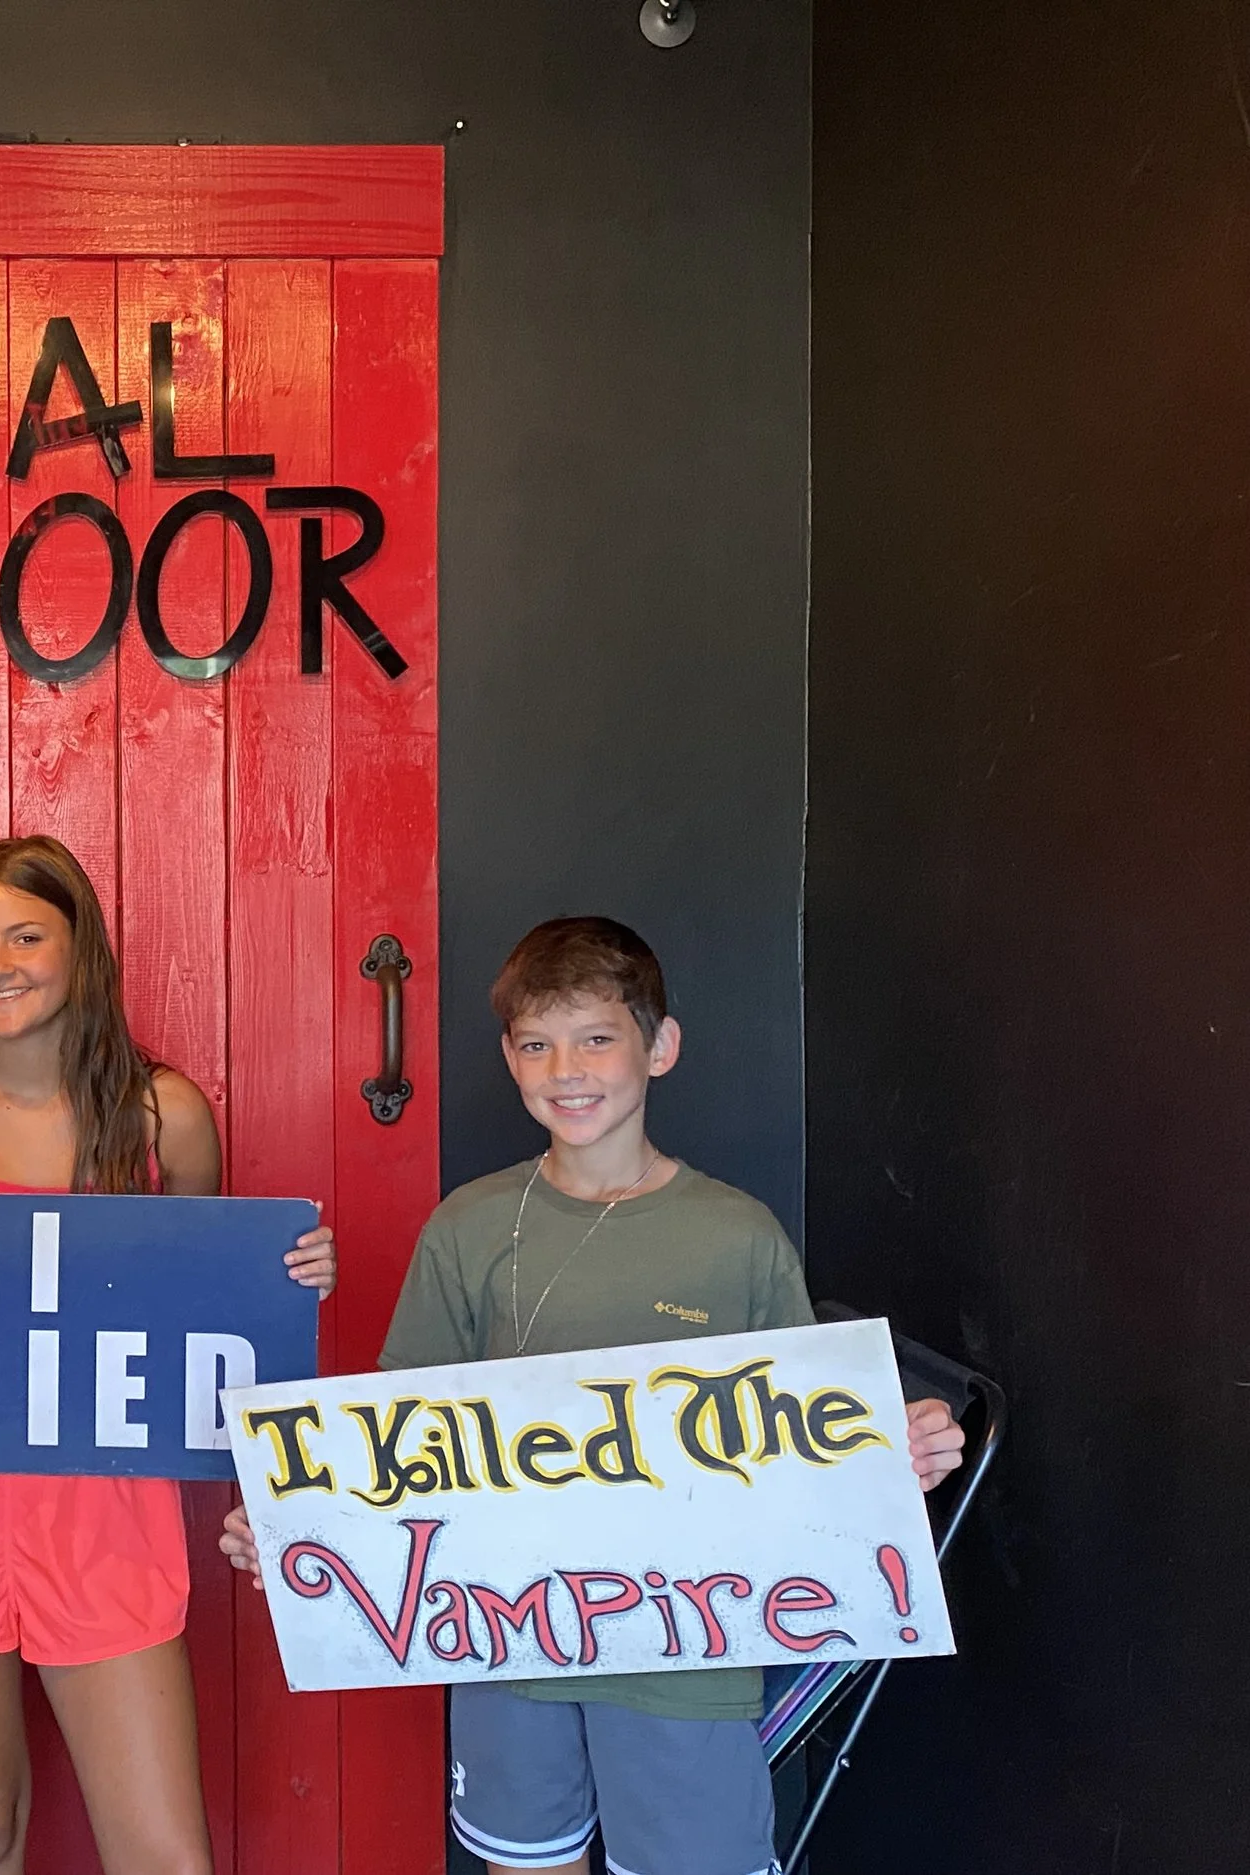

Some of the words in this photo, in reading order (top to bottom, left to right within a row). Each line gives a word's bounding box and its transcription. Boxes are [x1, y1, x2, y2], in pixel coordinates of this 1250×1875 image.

[31, 1212, 60, 1312] I
[665, 1303, 709, 1320] Columbia
[245, 1403, 336, 1498] I
[345, 1381, 658, 1510] Killed
[652, 1358, 888, 1486] The
